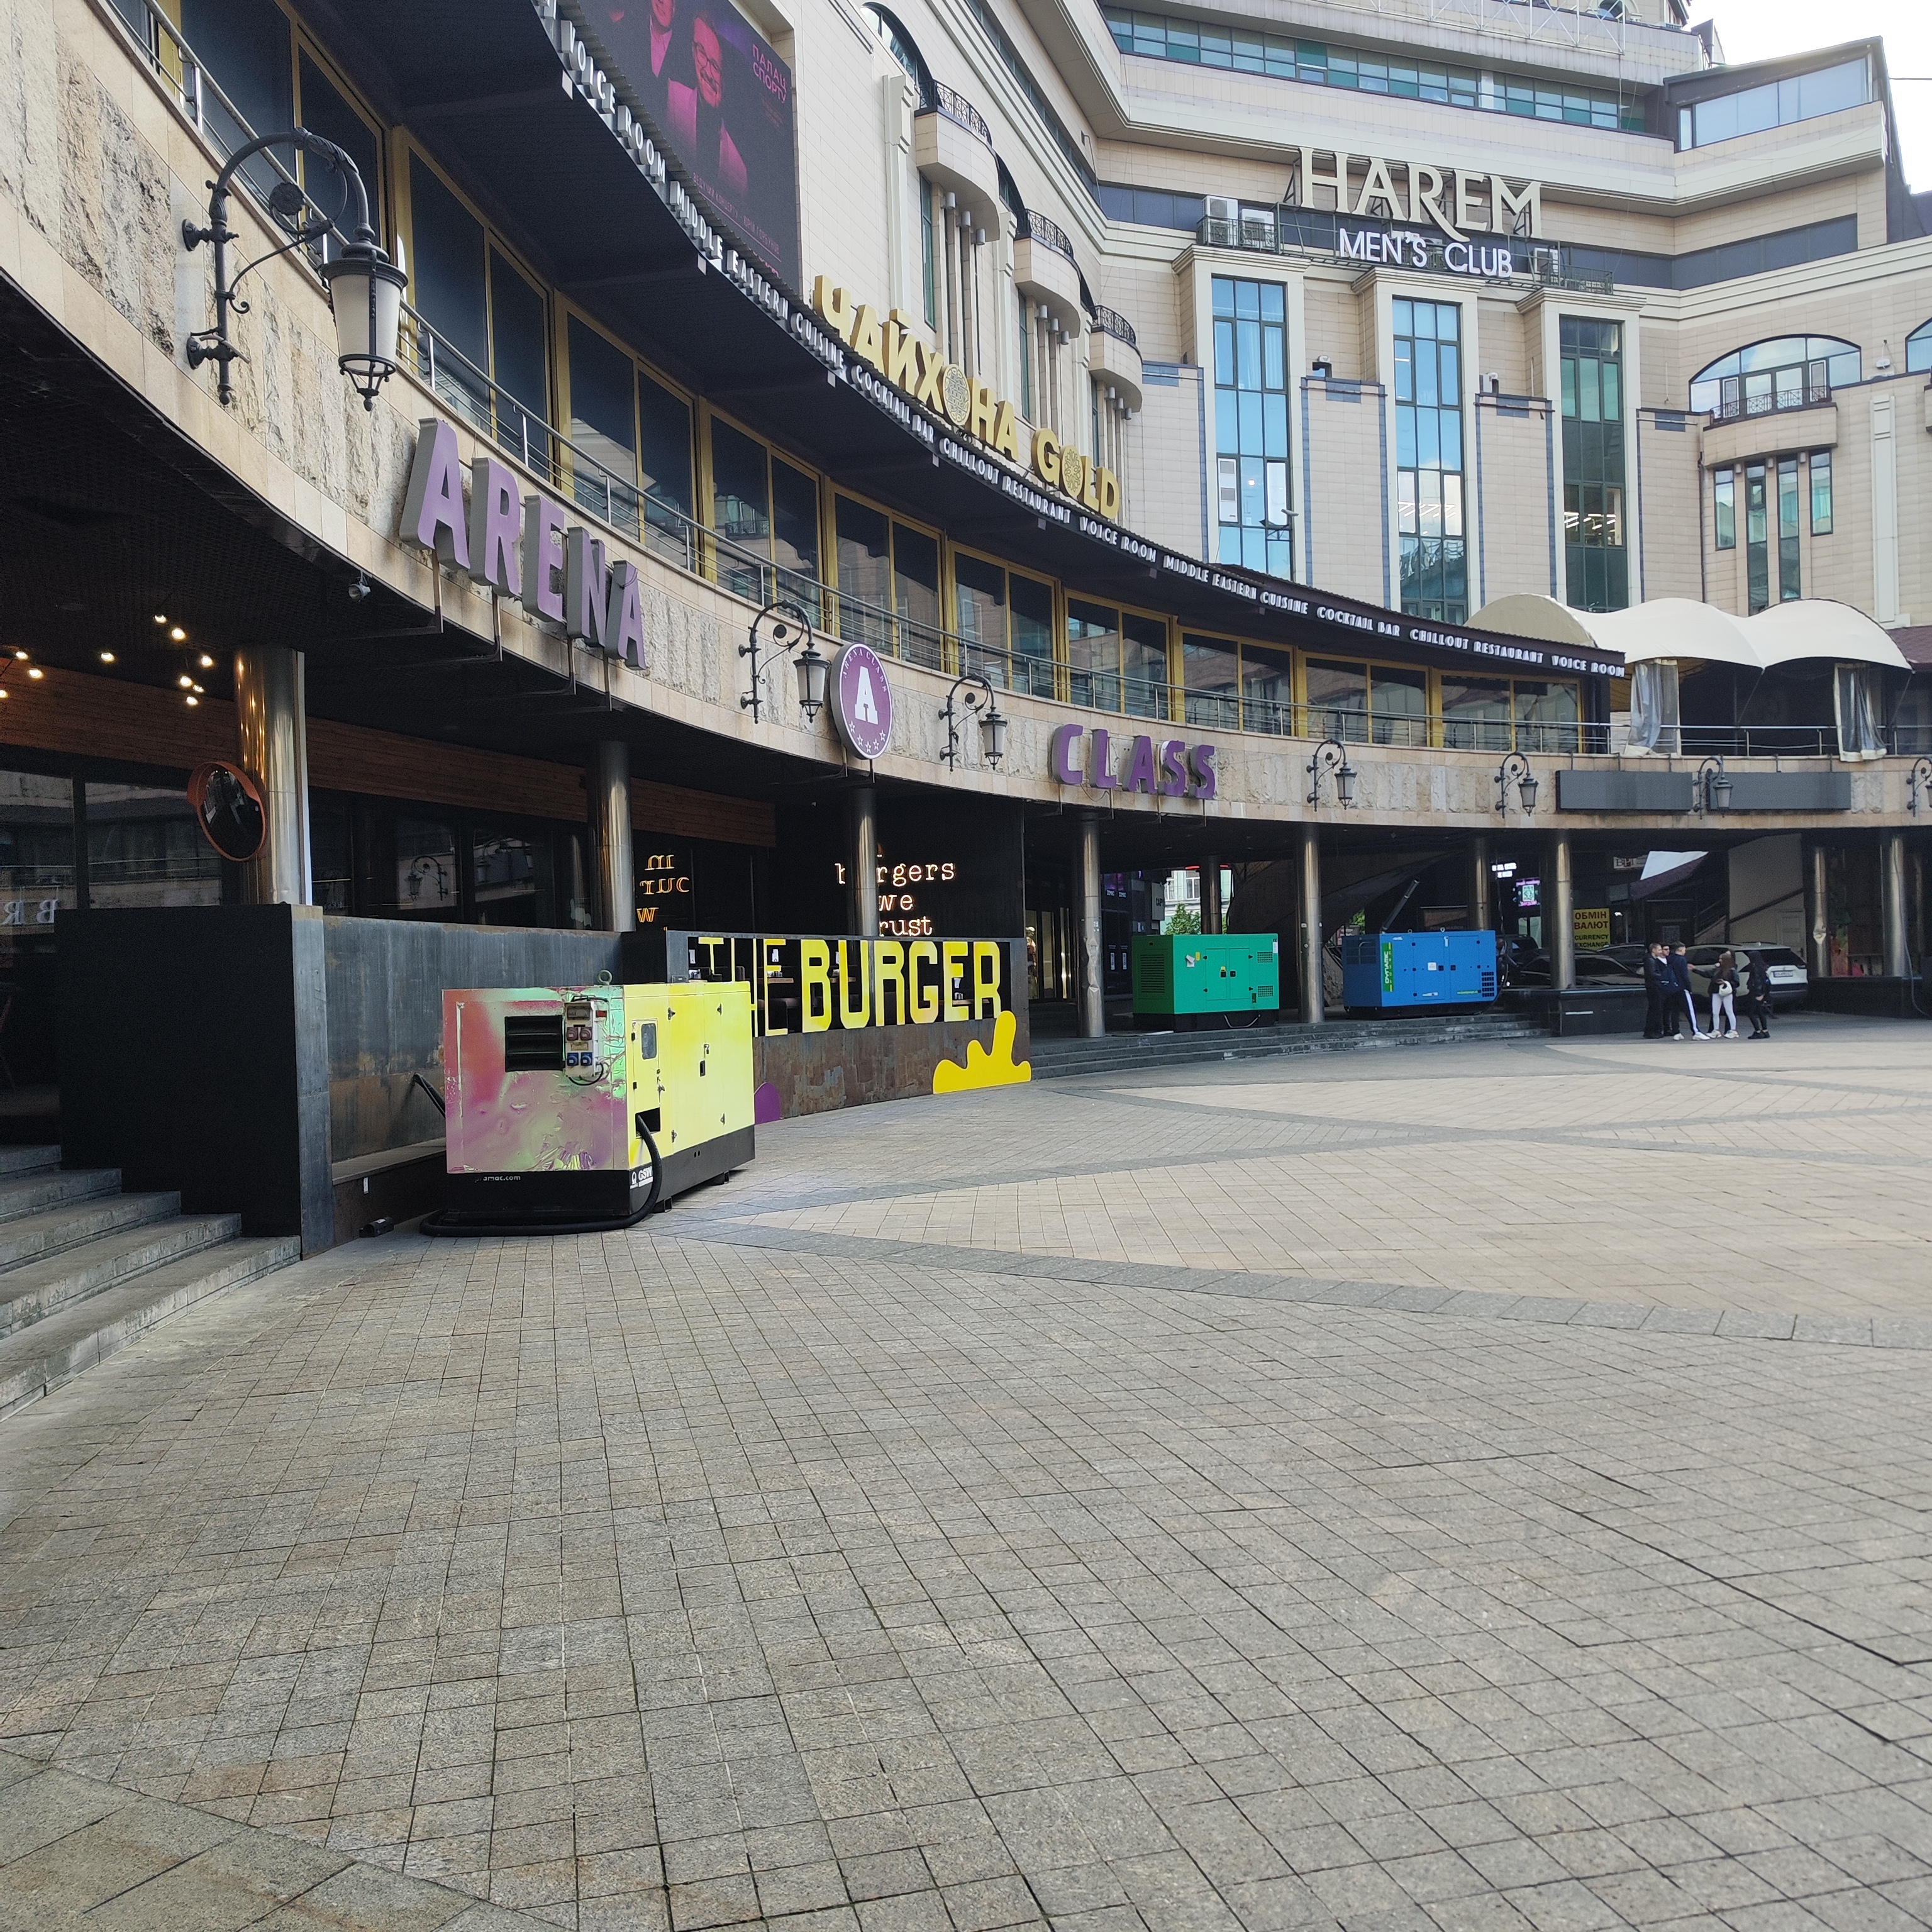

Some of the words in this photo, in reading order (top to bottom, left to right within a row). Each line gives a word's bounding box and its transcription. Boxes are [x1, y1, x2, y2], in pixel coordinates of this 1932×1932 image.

[753, 43, 787, 93] ПАЛАЦ
[753, 61, 786, 104] СПОРТУ
[1298, 147, 1541, 243] HAREM
[1340, 228, 1428, 268] MEN'S
[1445, 242, 1513, 278] CLUB
[561, 20, 616, 114] VOICE
[618, 105, 665, 184] ROOM
[670, 181, 725, 259] MIDDLE
[727, 250, 789, 320] EASTERN
[791, 313, 844, 369] CUISINE
[852, 365, 911, 425] COCKTAIL
[912, 415, 933, 443] BAR
[940, 438, 999, 485] CHILLOUT
[1002, 475, 1070, 525] RESTAURANT
[1079, 516, 1118, 545] VOICE
[1121, 536, 1157, 563] ROOM
[1163, 555, 1209, 583] MIDDLE
[1213, 573, 1257, 600] EASTERN
[1260, 591, 1308, 614] CUISINE
[1317, 606, 1373, 631] COCKTAIL
[1377, 621, 1400, 637] BAR
[1409, 628, 1469, 650] CHILLOUT
[1474, 641, 1543, 663] RESTAURANT
[1552, 655, 1587, 671] VOICE
[1591, 662, 1625, 677] ROOM
[399, 417, 646, 670] ARENA
[842, 648, 863, 679] ARENA
[866, 652, 887, 692] CLASS
[1052, 723, 1216, 800] CLASS
[879, 916, 933, 937] rust
[1574, 921, 1609, 930] ВАЛЮТ
[1575, 911, 1607, 919] ОБМІН
[801, 939, 1002, 1033] BURGER
[474, 1175, 521, 1184] amac.com
